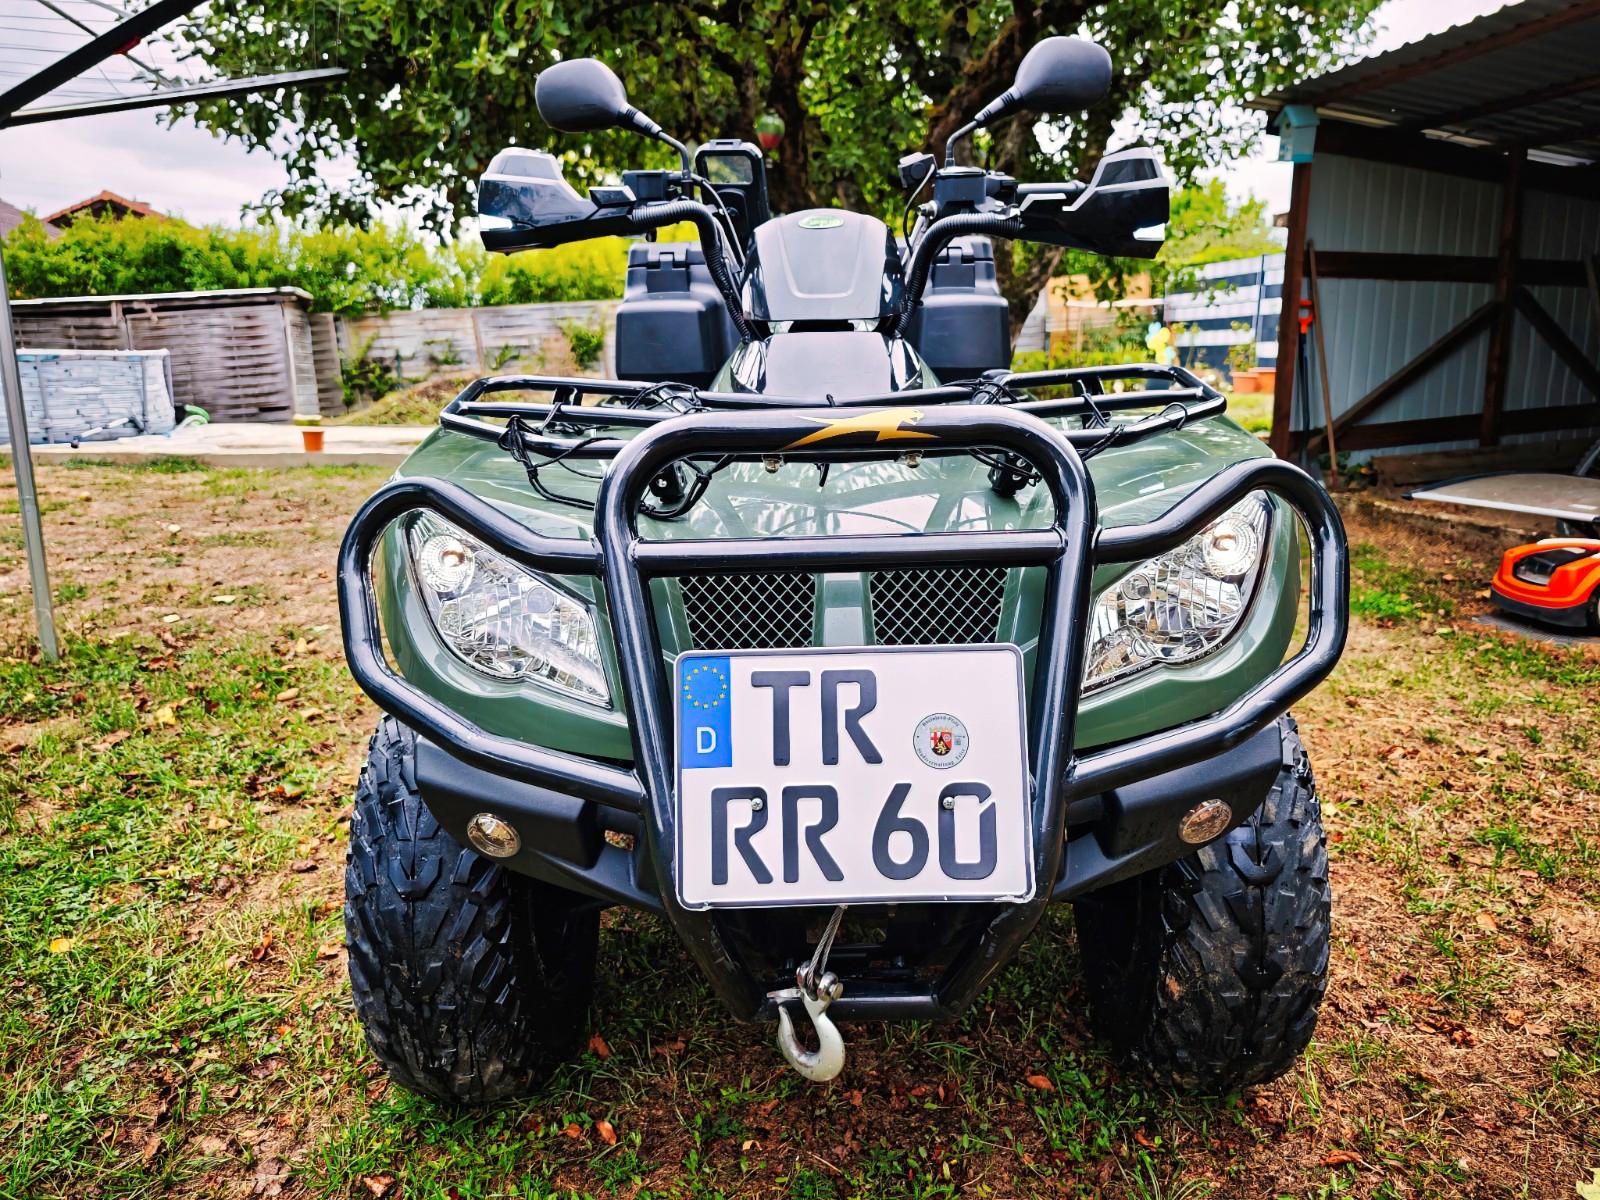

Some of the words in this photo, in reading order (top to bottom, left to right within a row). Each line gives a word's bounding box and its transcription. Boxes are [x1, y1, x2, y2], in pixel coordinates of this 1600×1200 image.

[696, 726, 717, 754] D
[750, 670, 883, 766] TR
[711, 785, 844, 885] RR
[872, 782, 997, 880] 60
